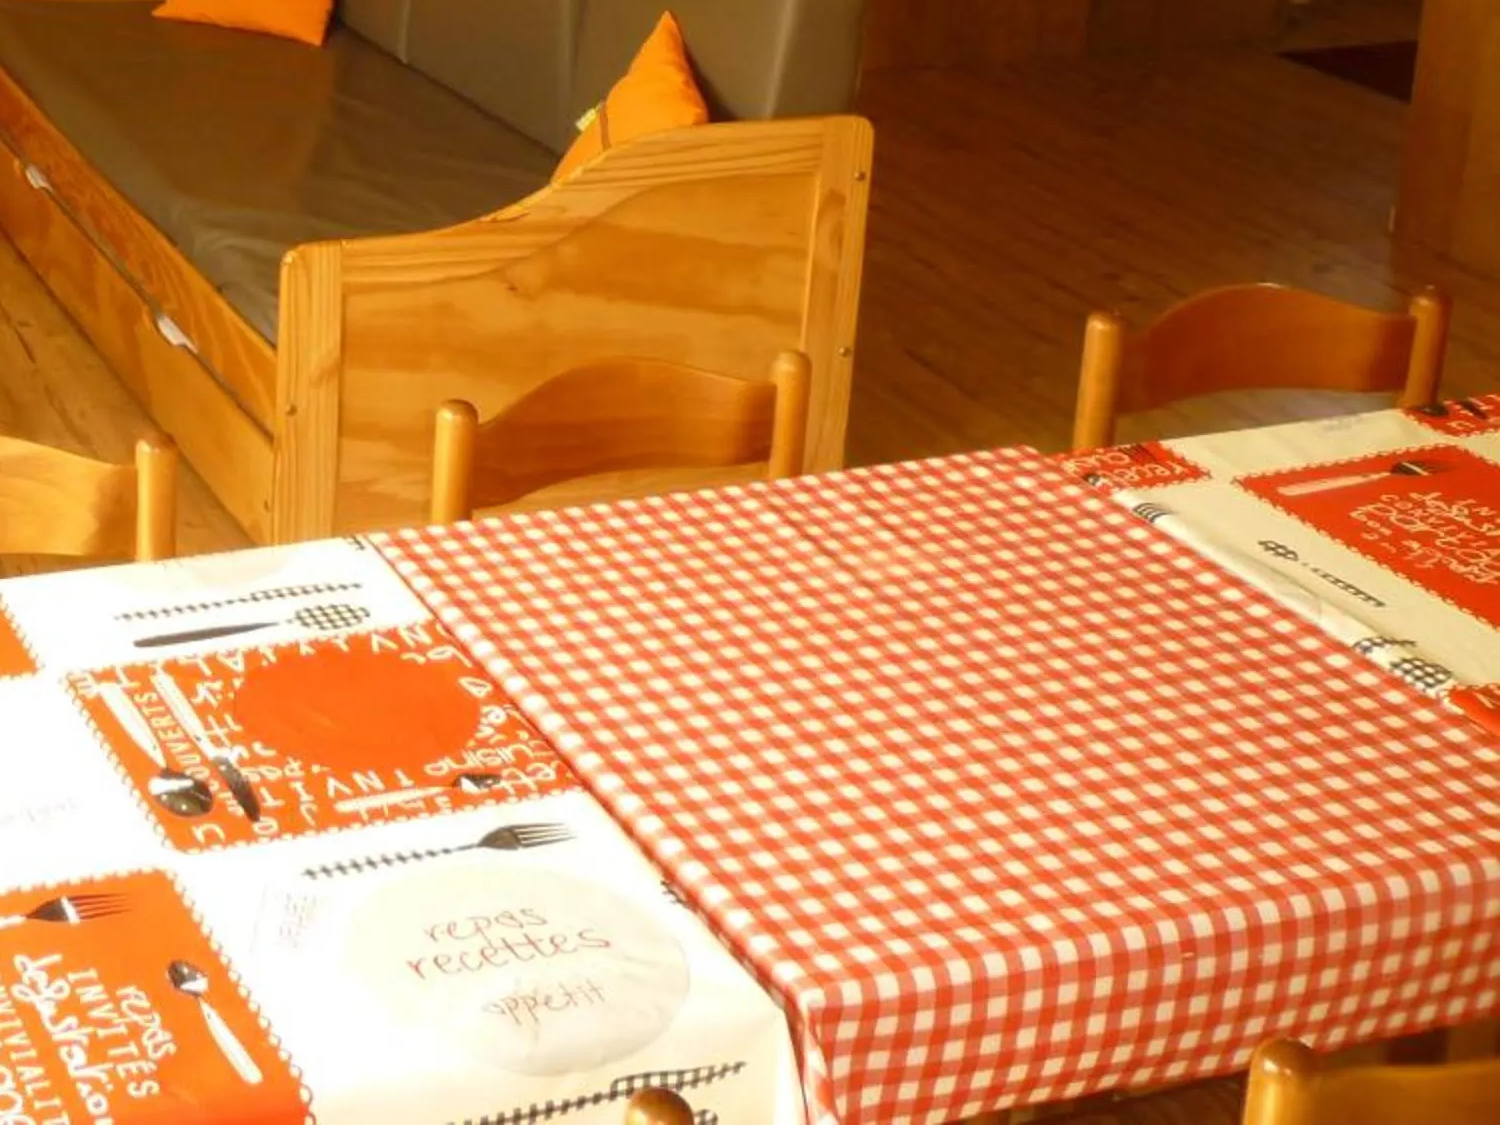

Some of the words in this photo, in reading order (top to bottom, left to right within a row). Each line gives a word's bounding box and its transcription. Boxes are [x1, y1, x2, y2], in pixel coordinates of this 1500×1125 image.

[406, 928, 612, 981] recettes
[423, 907, 549, 950] repas
[67, 967, 161, 1100] INVITÉS
